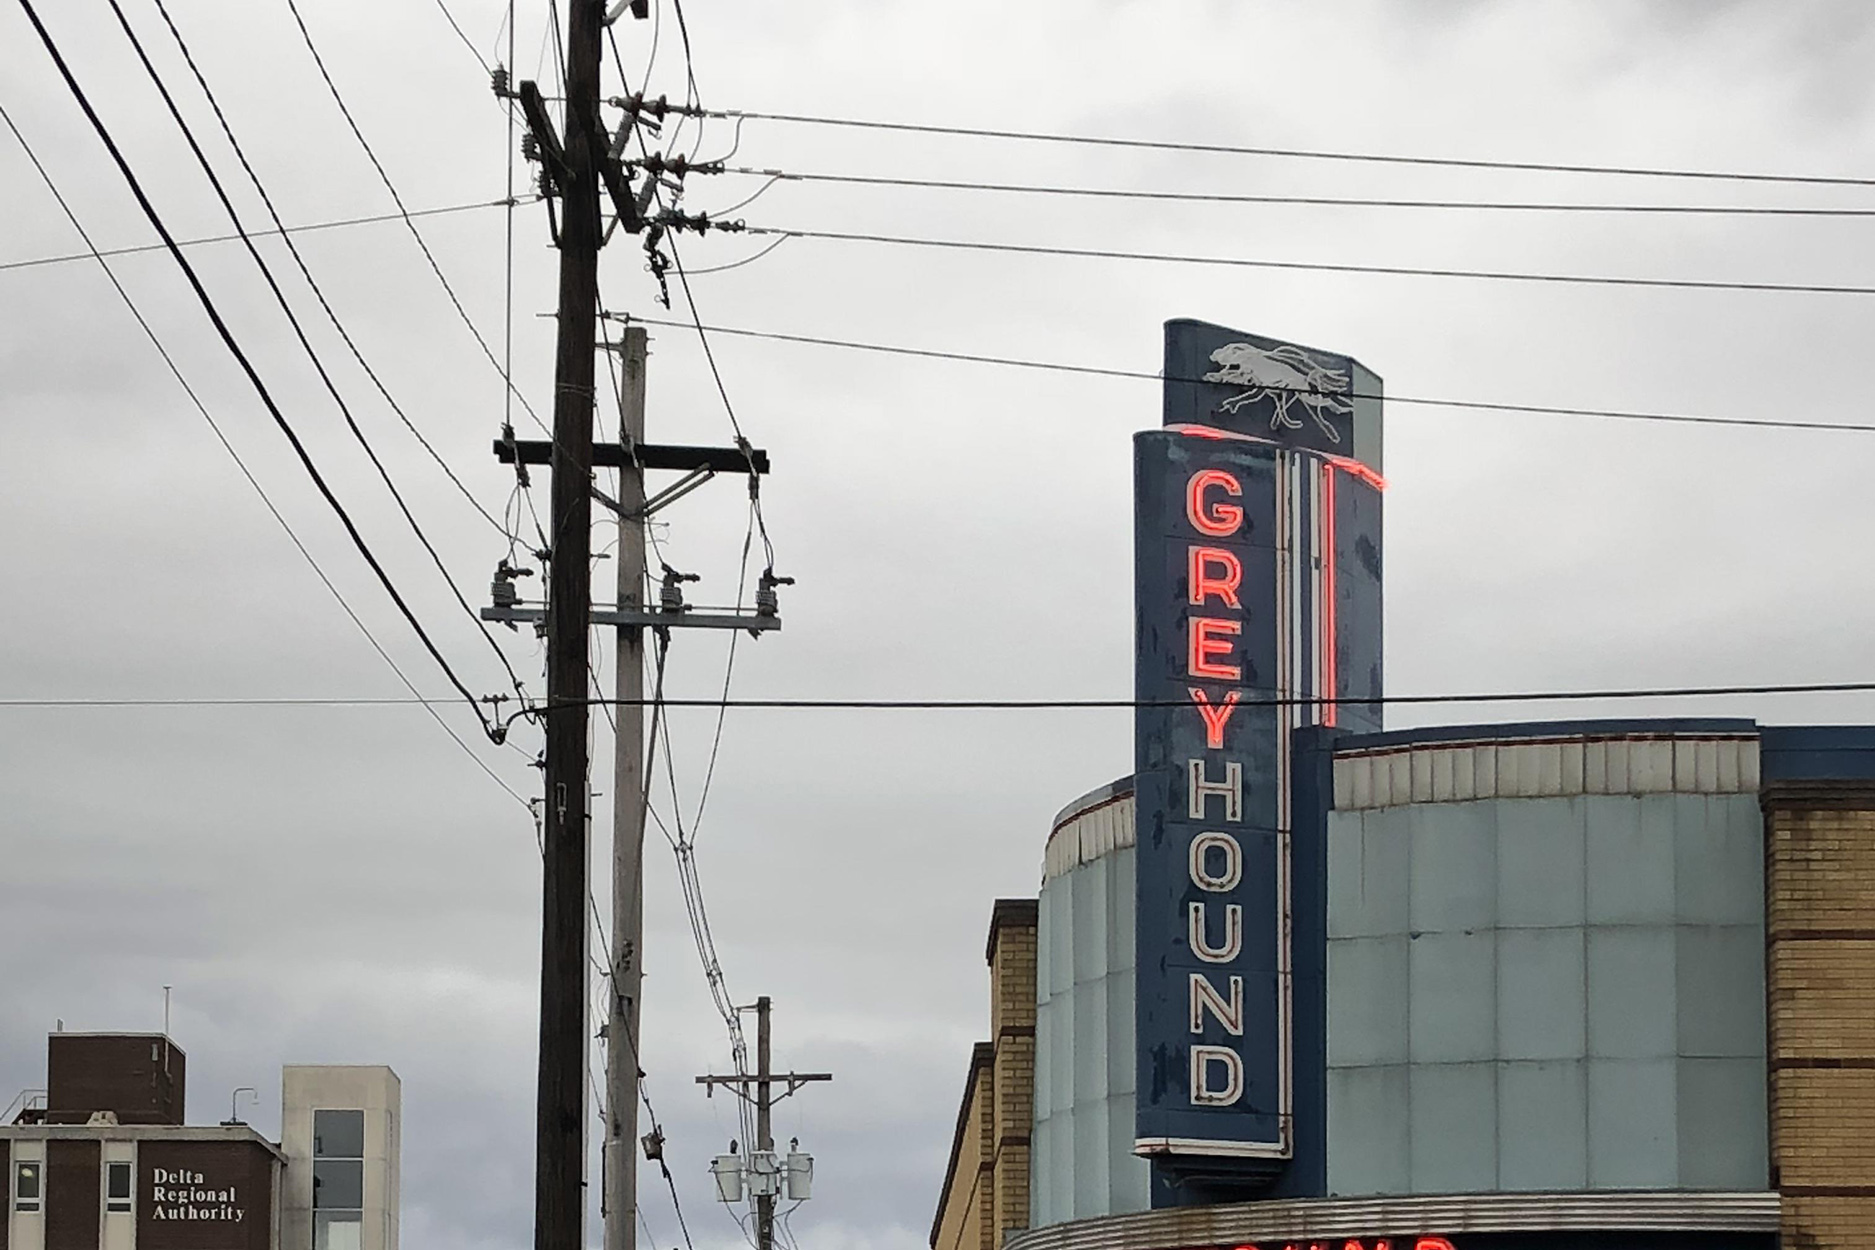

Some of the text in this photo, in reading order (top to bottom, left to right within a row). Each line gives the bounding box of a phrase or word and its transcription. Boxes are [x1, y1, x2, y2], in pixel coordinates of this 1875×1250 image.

[1185, 468, 1244, 1107] GREYHOUND
[152, 1168, 204, 1184] Delta
[152, 1186, 236, 1204] Regional
[152, 1204, 245, 1223] Authority
